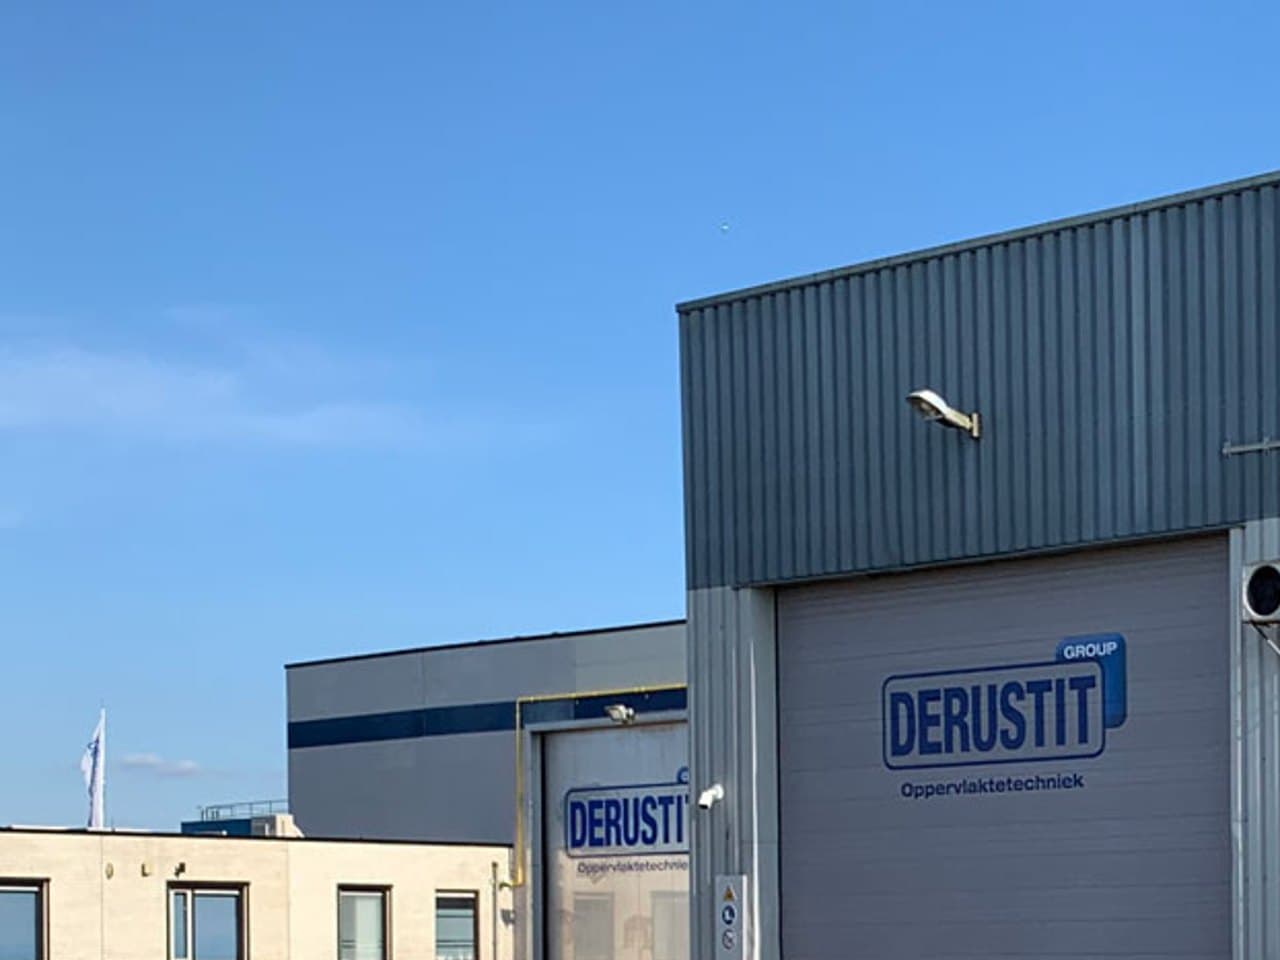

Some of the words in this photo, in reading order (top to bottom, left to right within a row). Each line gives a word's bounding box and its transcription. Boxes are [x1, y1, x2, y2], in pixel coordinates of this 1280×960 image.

[1063, 641, 1118, 660] GROUP
[889, 675, 1097, 758] DERUSTIT
[901, 773, 1085, 800] Oppervlaktetechniek
[570, 794, 688, 848] DERUSTI
[577, 861, 688, 875] Oppervlaktetechnie
